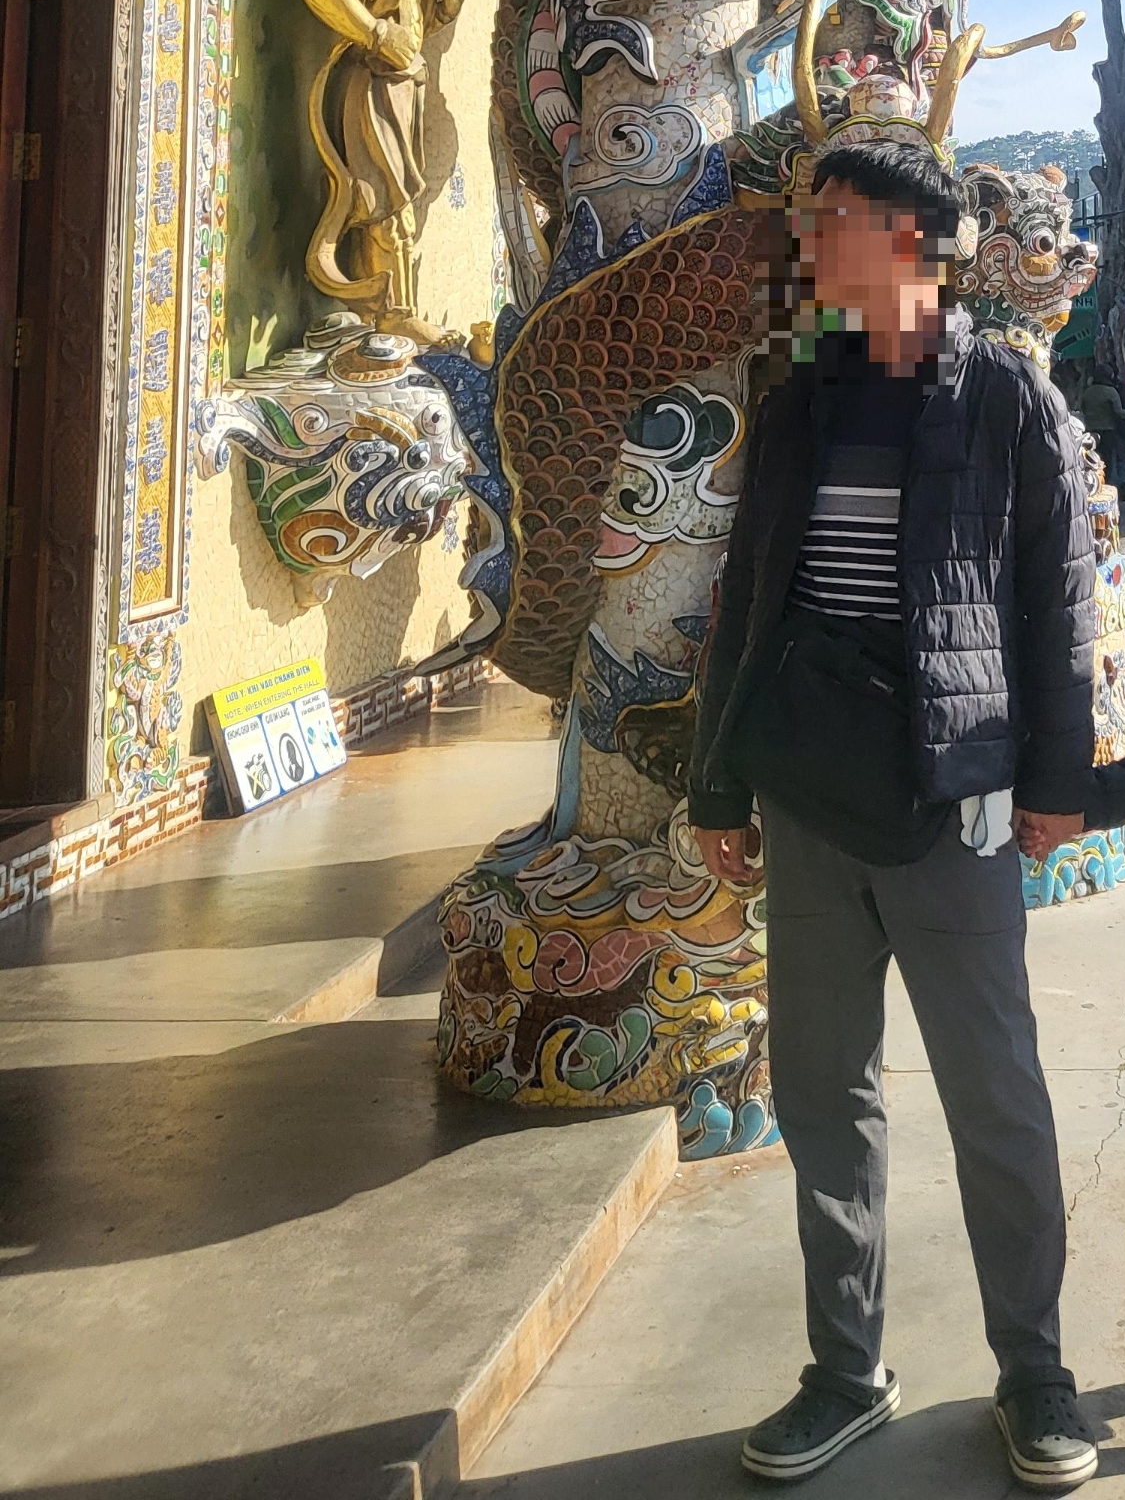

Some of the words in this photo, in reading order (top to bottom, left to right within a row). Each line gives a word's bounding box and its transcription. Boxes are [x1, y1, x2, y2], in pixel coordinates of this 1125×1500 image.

[244, 700, 263, 713] WHEN
[263, 688, 292, 706] ENTERING
[292, 684, 304, 695] THE
[304, 679, 320, 690] HALL
